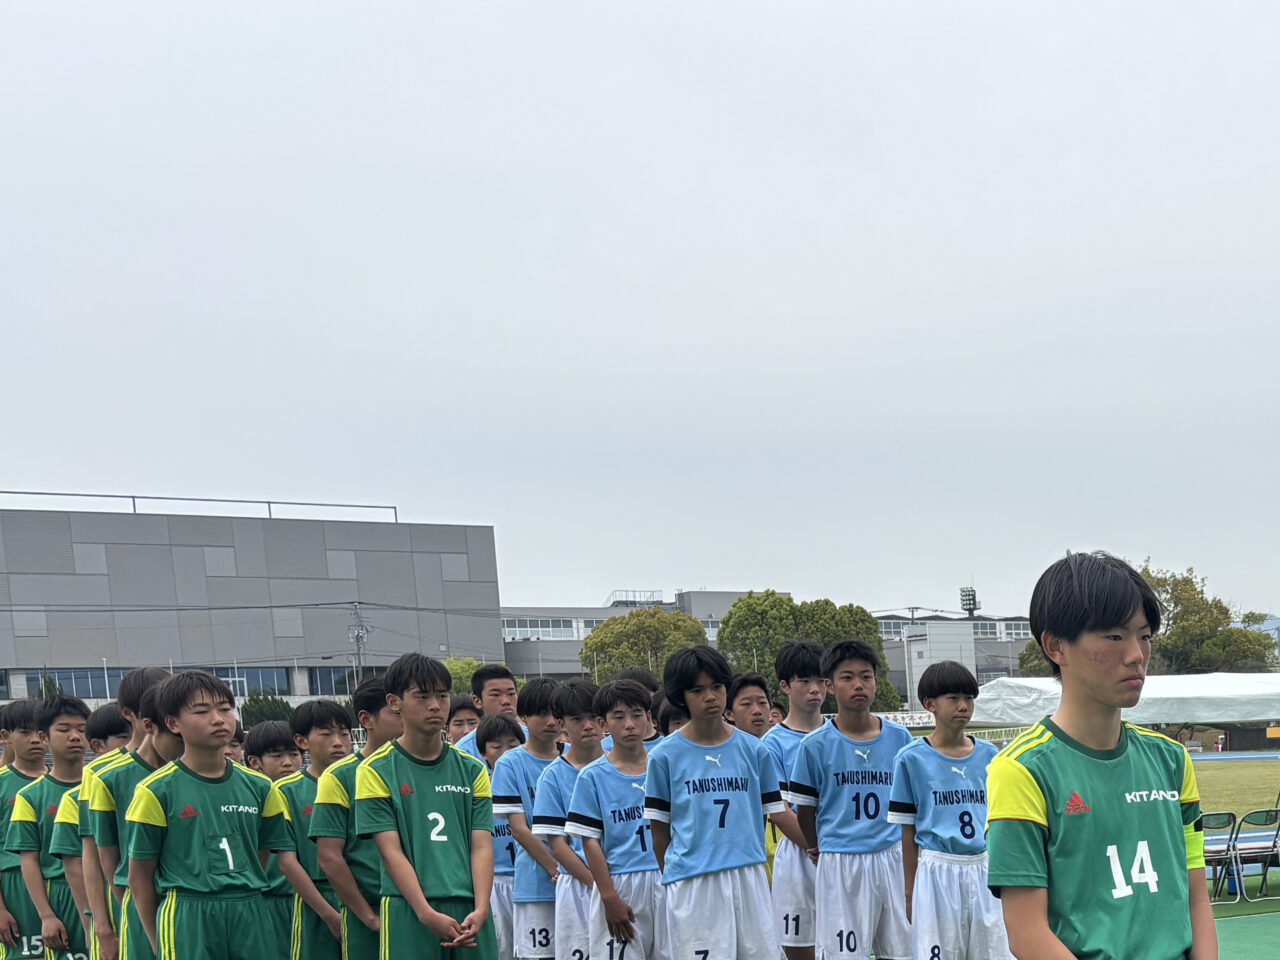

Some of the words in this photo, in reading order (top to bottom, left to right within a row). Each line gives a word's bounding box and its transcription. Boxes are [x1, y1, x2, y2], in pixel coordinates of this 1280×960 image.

[852, 792, 880, 820] 10
[932, 789, 986, 806] TANUSHIMAR
[1125, 789, 1180, 803] KITANO
[221, 804, 259, 815] KITANO
[713, 799, 730, 828] 7
[427, 812, 448, 841] 2
[636, 824, 651, 852] 1
[958, 810, 976, 840] 8
[219, 837, 234, 871] 1
[1106, 840, 1159, 899] 14
[783, 913, 800, 936] 11
[21, 935, 44, 956] 15
[529, 927, 551, 949] 13
[836, 929, 857, 953] 10
